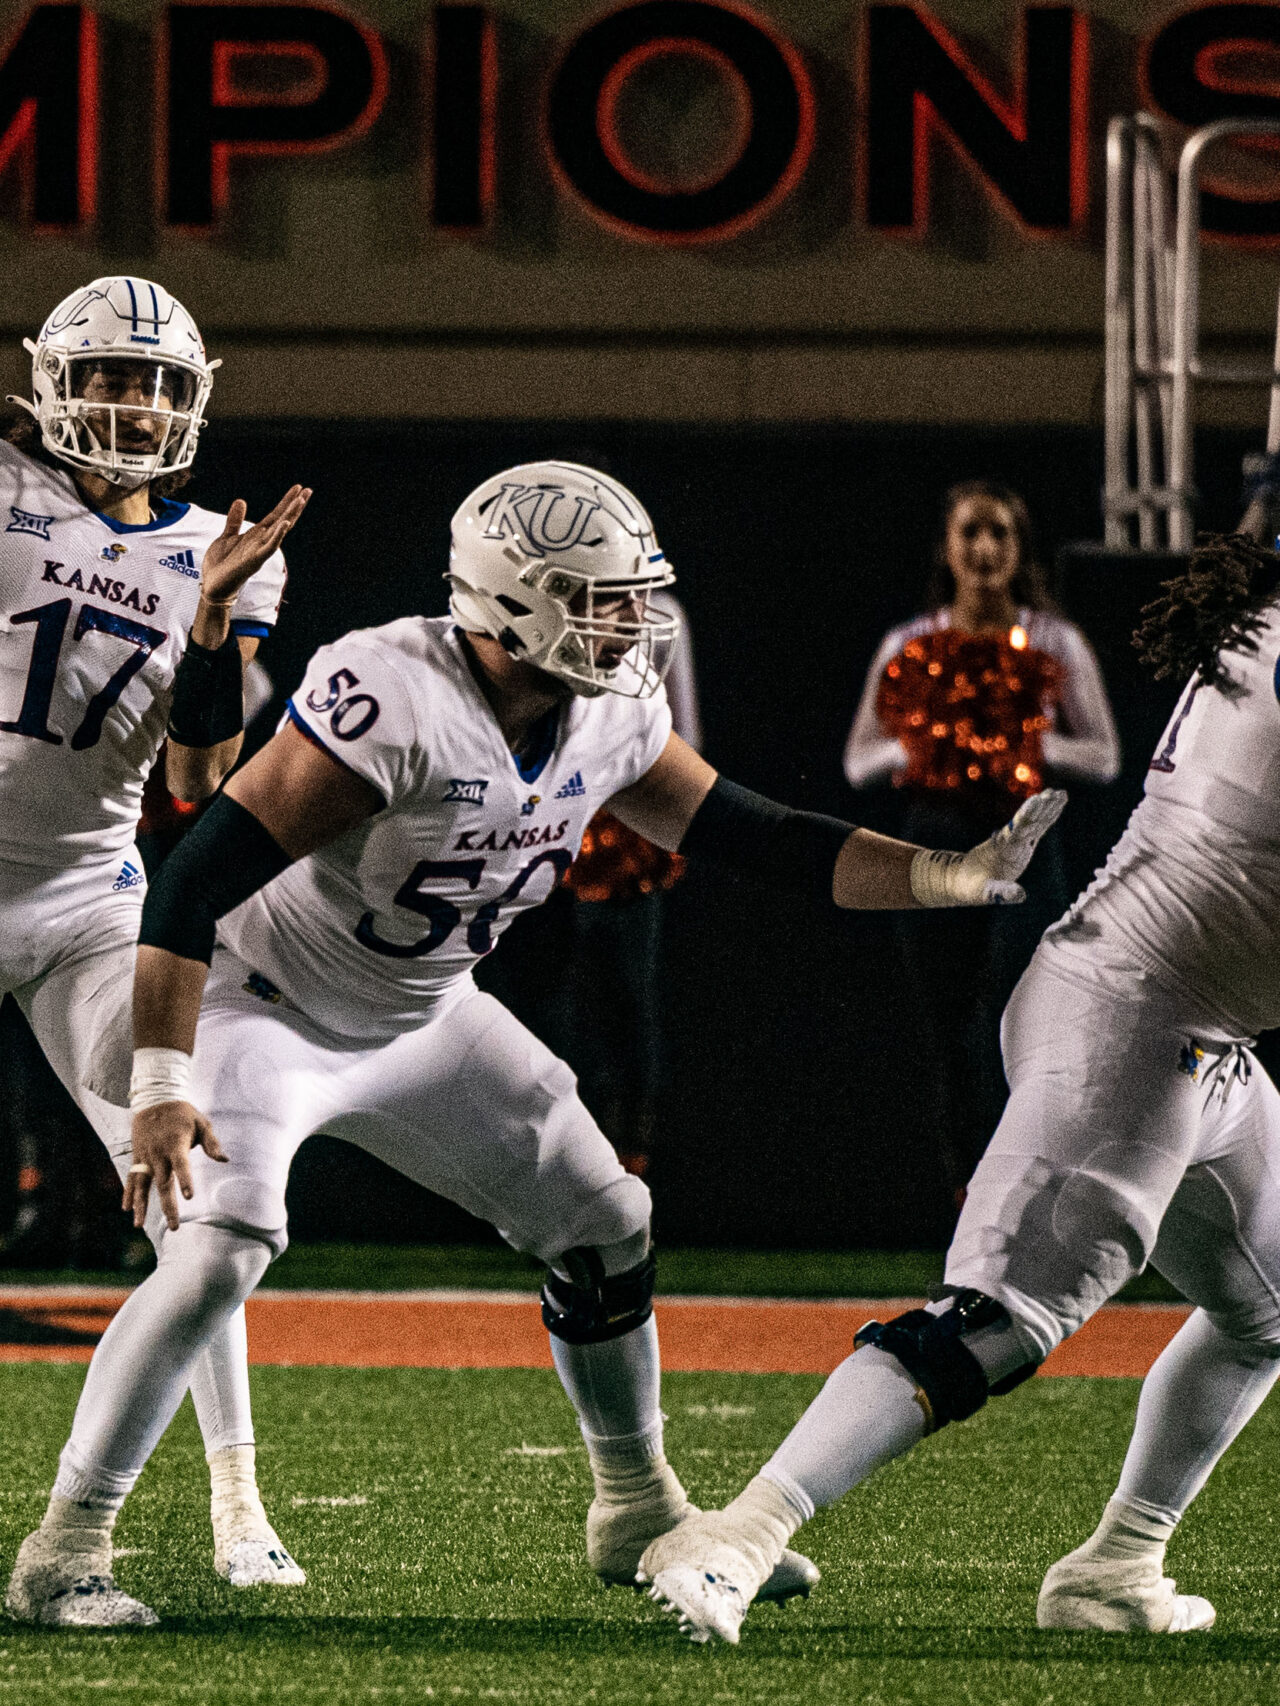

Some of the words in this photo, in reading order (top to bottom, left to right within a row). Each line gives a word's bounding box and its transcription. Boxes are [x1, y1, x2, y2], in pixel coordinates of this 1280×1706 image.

[479, 482, 602, 558] KU
[40, 559, 161, 616] KANSAS
[158, 558, 200, 580] adidas
[305, 667, 381, 743] 50
[452, 819, 570, 851] KANSAS
[112, 875, 145, 891] adidas
